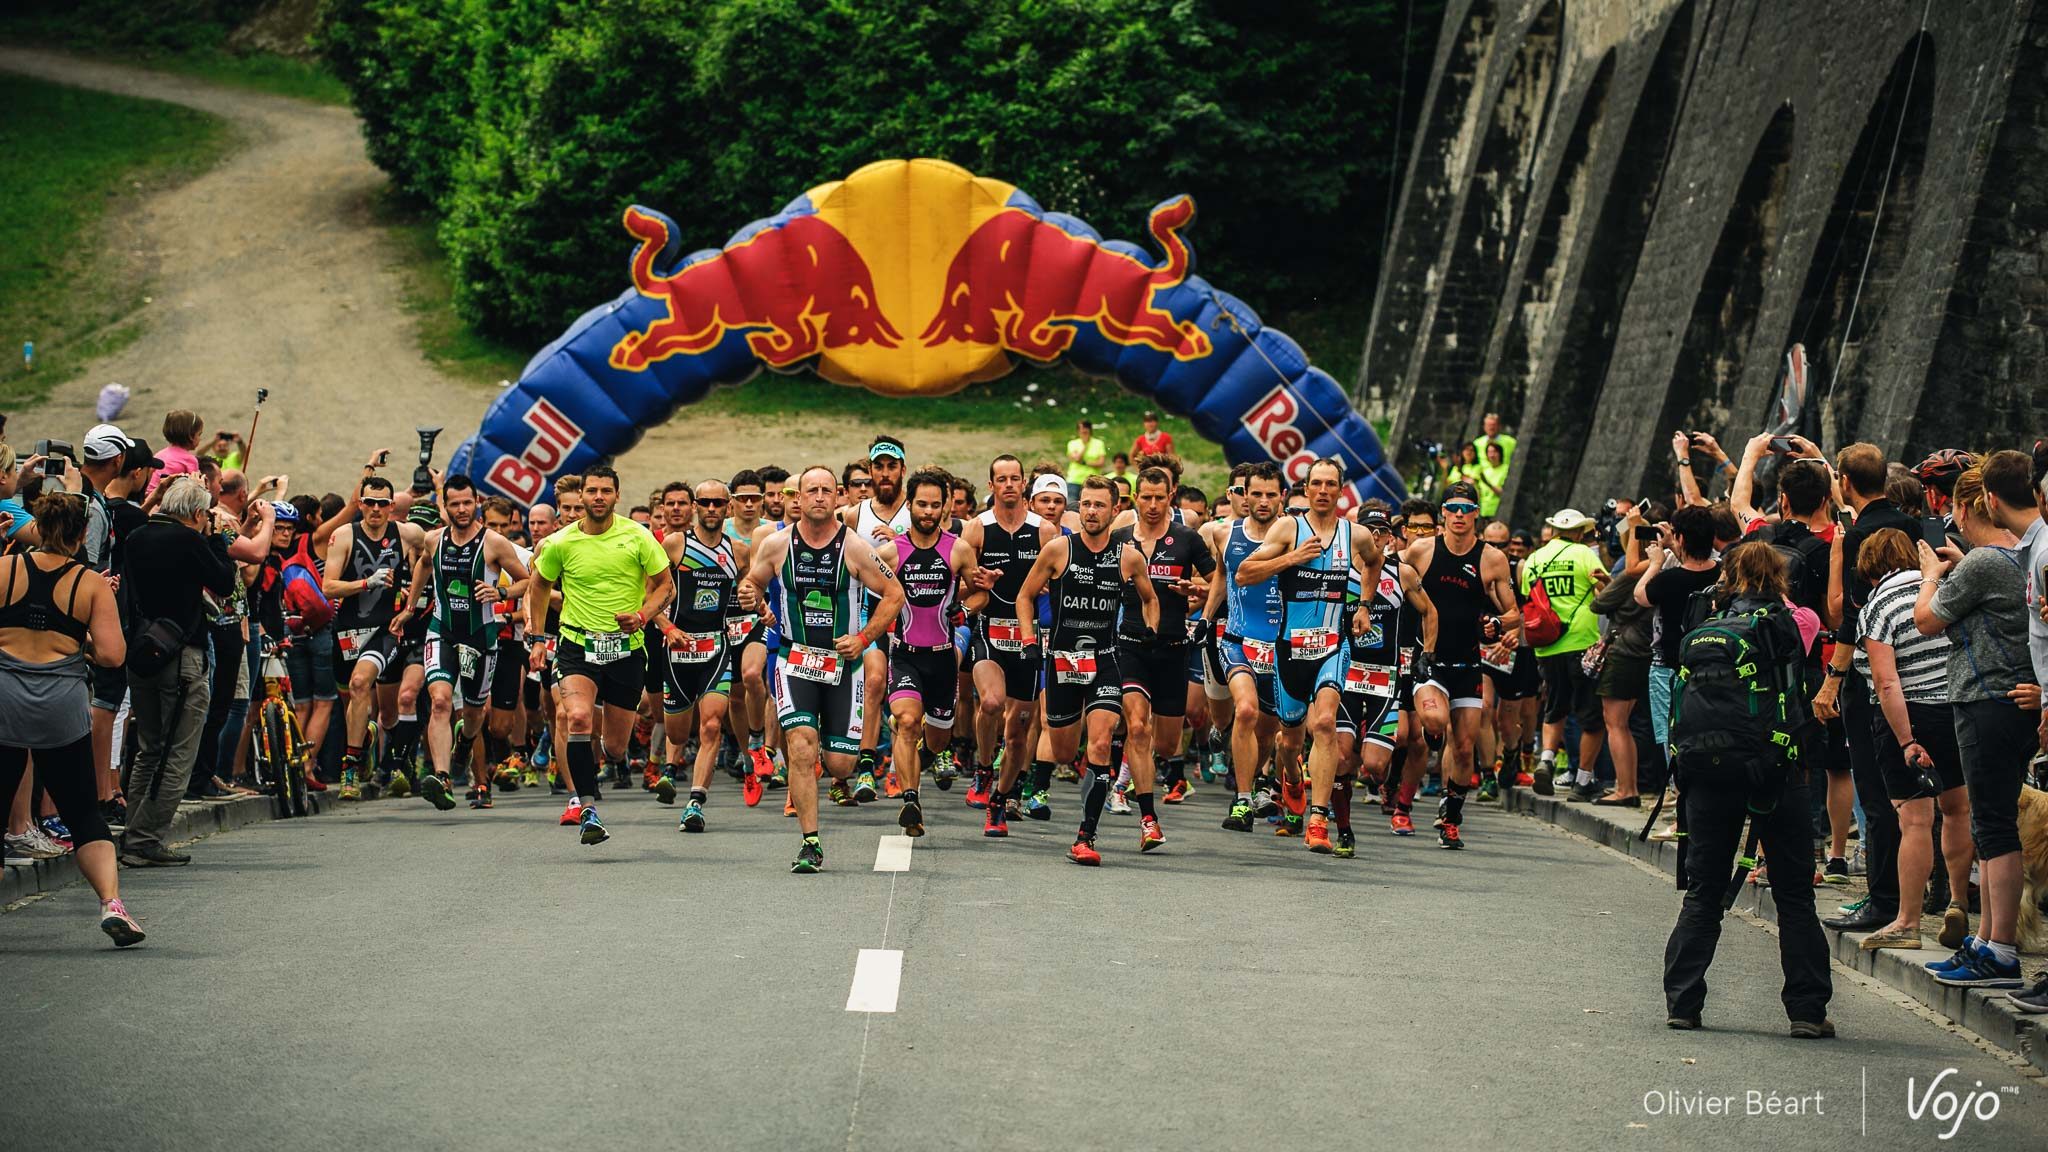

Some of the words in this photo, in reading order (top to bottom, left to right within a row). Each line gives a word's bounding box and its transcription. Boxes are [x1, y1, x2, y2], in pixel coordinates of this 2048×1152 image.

[484, 397, 585, 508] Bull
[874, 444, 897, 453] HOKA
[1069, 563, 1094, 575] Optic
[1297, 570, 1322, 579] WOLF
[904, 573, 944, 581] LARRUZEA
[1073, 572, 1094, 580] 2000
[1545, 577, 1571, 596] EW
[805, 617, 834, 625] EXPO
[728, 623, 742, 635] 34
[1008, 627, 1015, 640] 1
[592, 639, 622, 653] 1003
[689, 640, 697, 652] 3
[1358, 636, 1382, 647] DRINK
[801, 653, 825, 668] 186
[1256, 648, 1269, 662] 21
[793, 665, 827, 679] MUCHERY
[1363, 671, 1371, 681] 2
